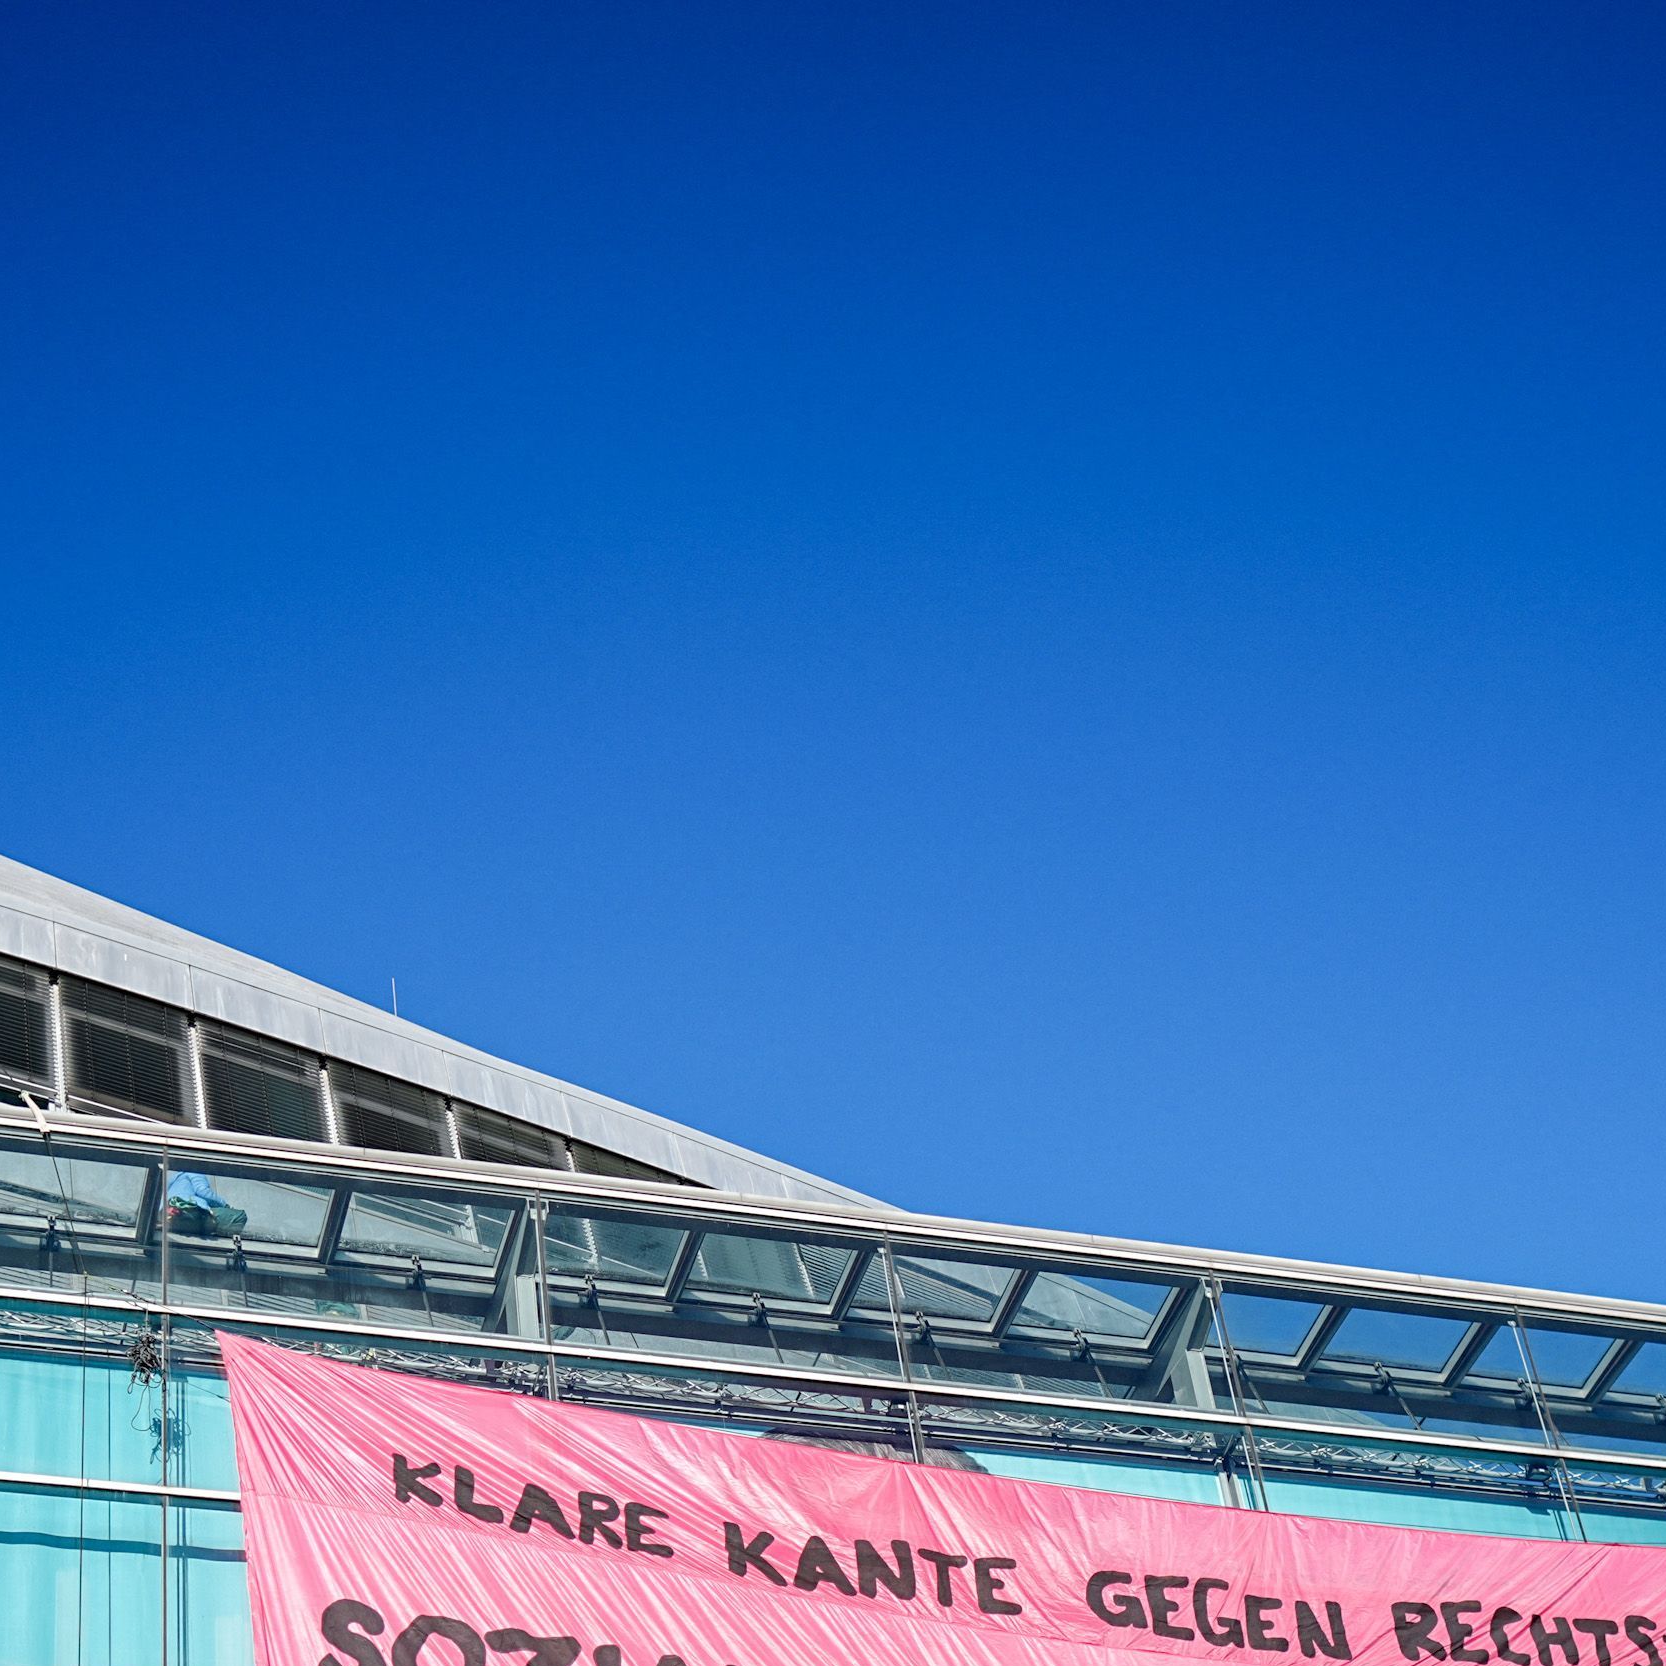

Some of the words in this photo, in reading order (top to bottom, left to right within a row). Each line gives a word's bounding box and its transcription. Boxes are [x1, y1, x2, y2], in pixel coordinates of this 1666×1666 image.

[392, 1453, 674, 1558] KLARE
[724, 1521, 1023, 1616] KANTE
[1086, 1569, 1351, 1661] GEGEN
